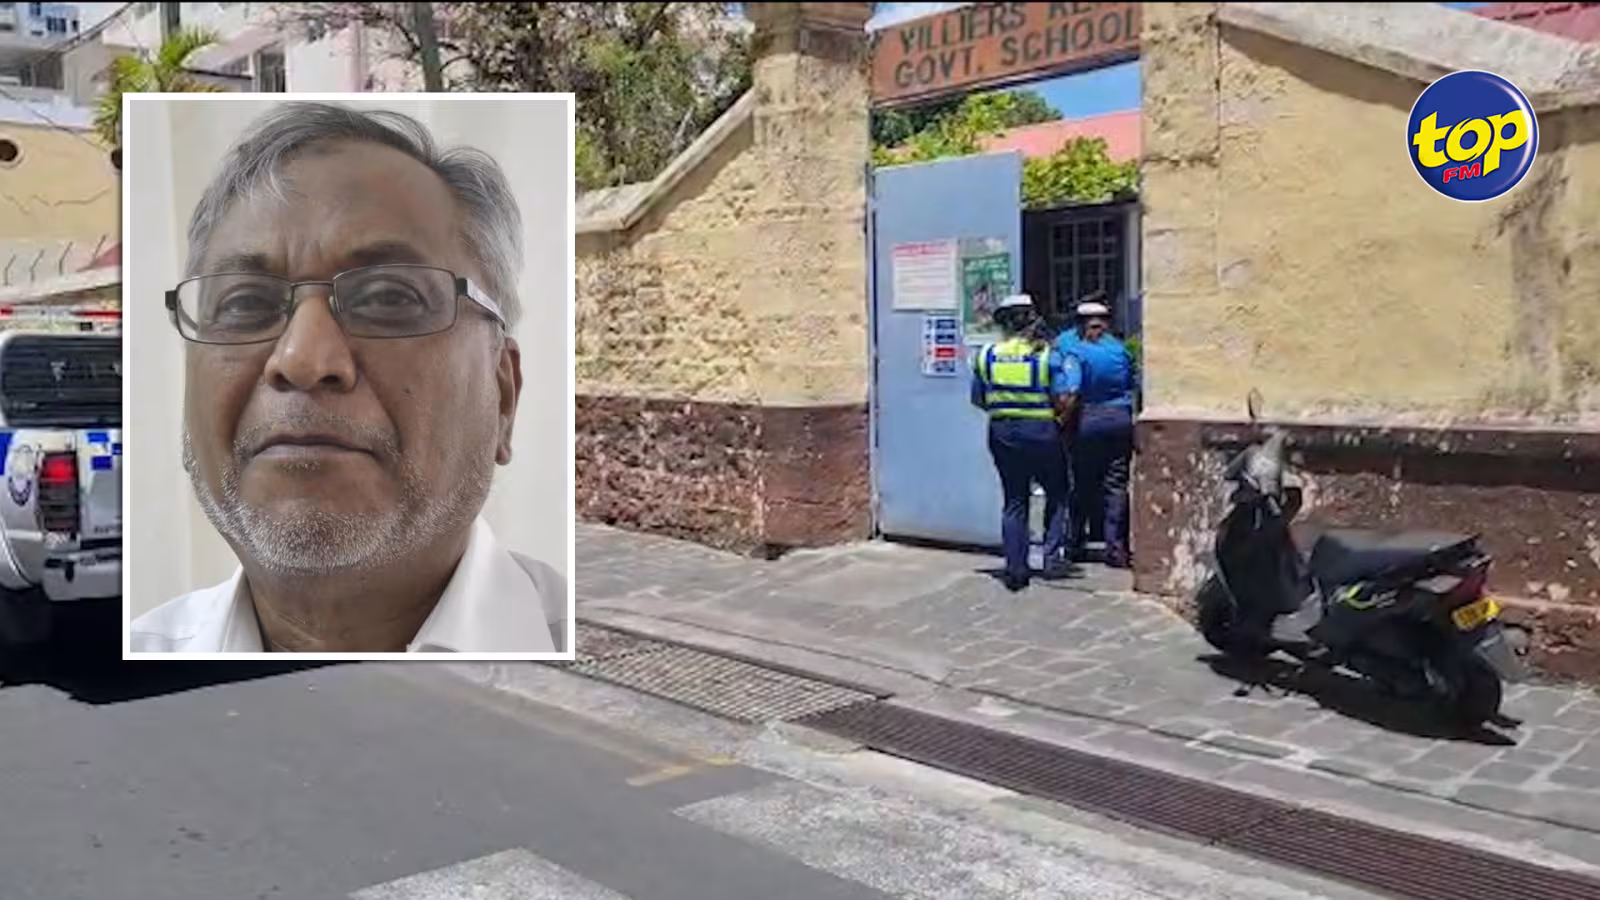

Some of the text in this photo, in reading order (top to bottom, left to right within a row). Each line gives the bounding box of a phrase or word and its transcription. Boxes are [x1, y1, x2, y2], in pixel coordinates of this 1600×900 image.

[895, 10, 1139, 87] GOVT. SCHOOL
[900, 3, 1025, 53] VILLIERS
